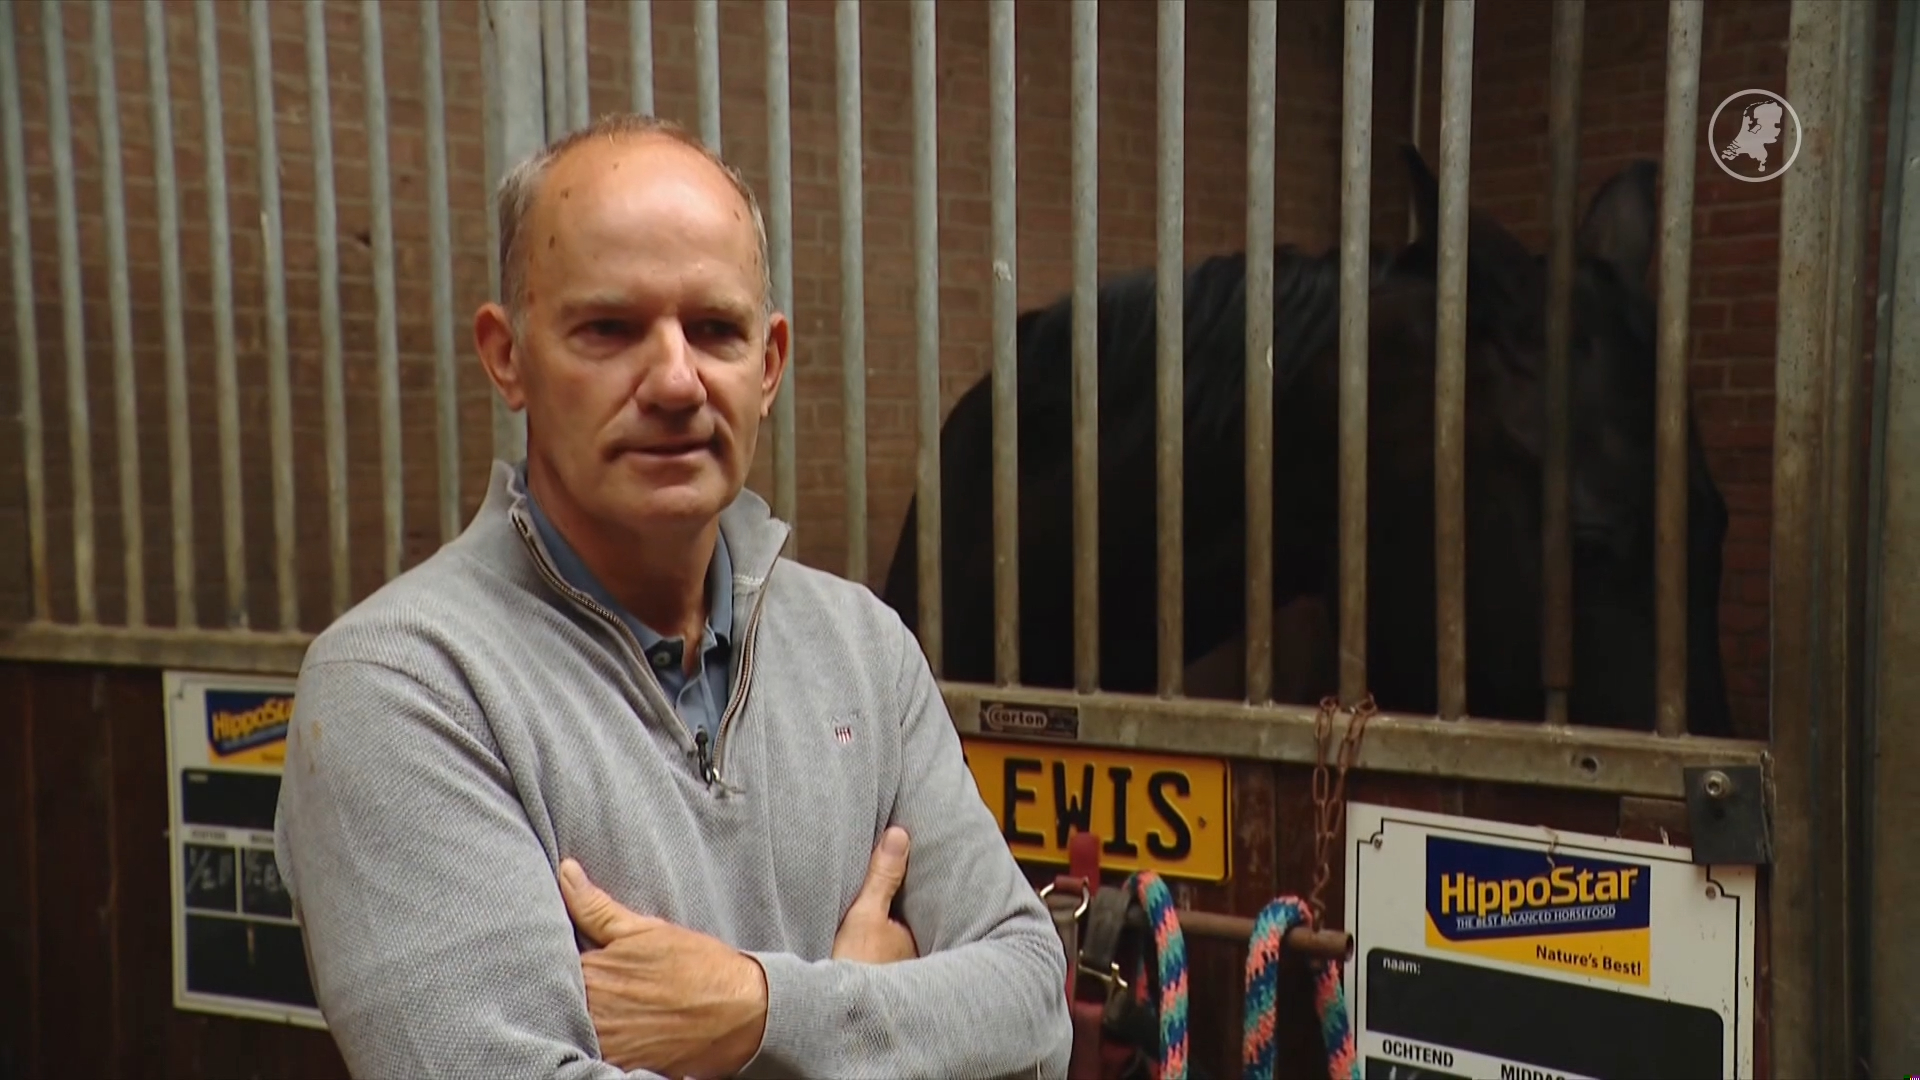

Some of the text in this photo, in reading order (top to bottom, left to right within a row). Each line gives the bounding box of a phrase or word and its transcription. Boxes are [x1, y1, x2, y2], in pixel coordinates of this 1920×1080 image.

[1441, 866, 1639, 917] HippoStar
[1456, 905, 1616, 930] THE BEST BALANCED HORSEFOOD
[1382, 956, 1421, 976] naam:
[1536, 944, 1642, 976] Nature's Best!
[1382, 1039, 1454, 1068] OCHTEND
[1501, 1063, 1566, 1080] MIDD
